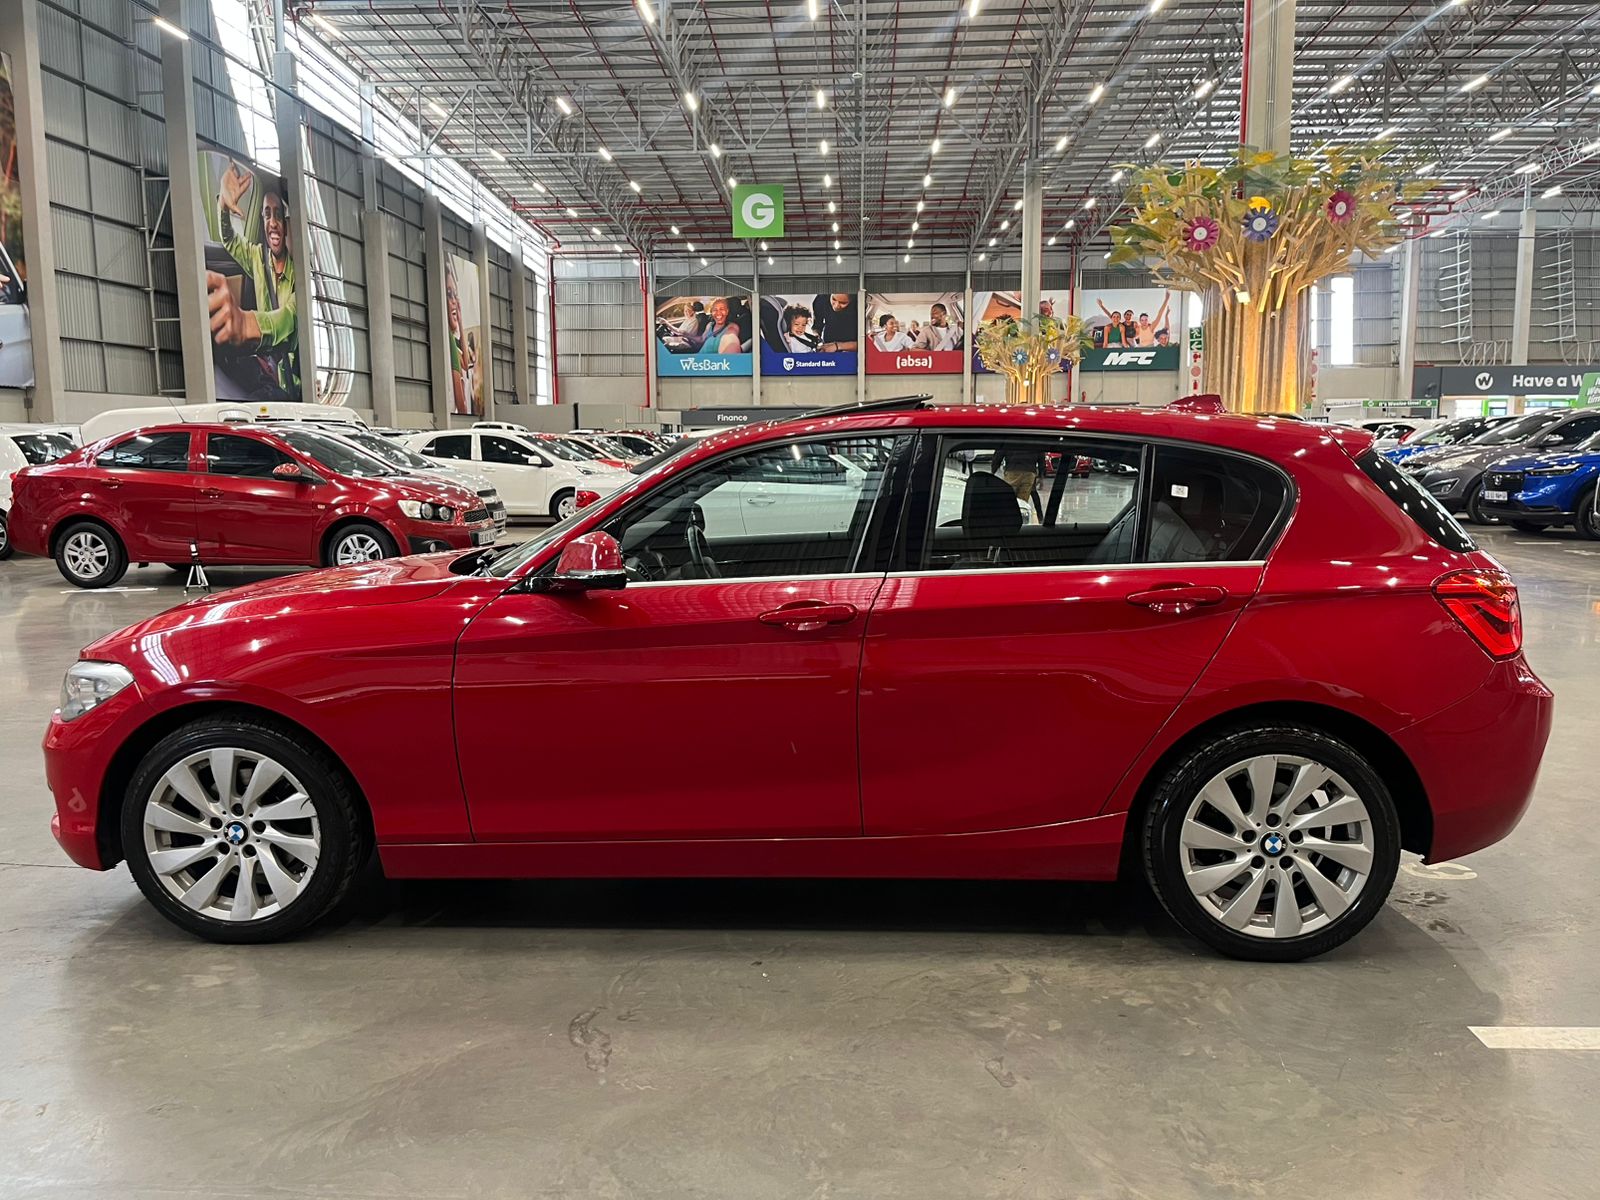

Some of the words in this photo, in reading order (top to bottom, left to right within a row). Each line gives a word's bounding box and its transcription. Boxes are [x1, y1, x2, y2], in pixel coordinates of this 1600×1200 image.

[741, 193, 775, 229] G
[680, 357, 731, 371] WesBank
[1102, 351, 1157, 366] MFC
[1512, 374, 1554, 387] Have
[1556, 377, 1568, 387] a
[716, 414, 748, 422] Finance
